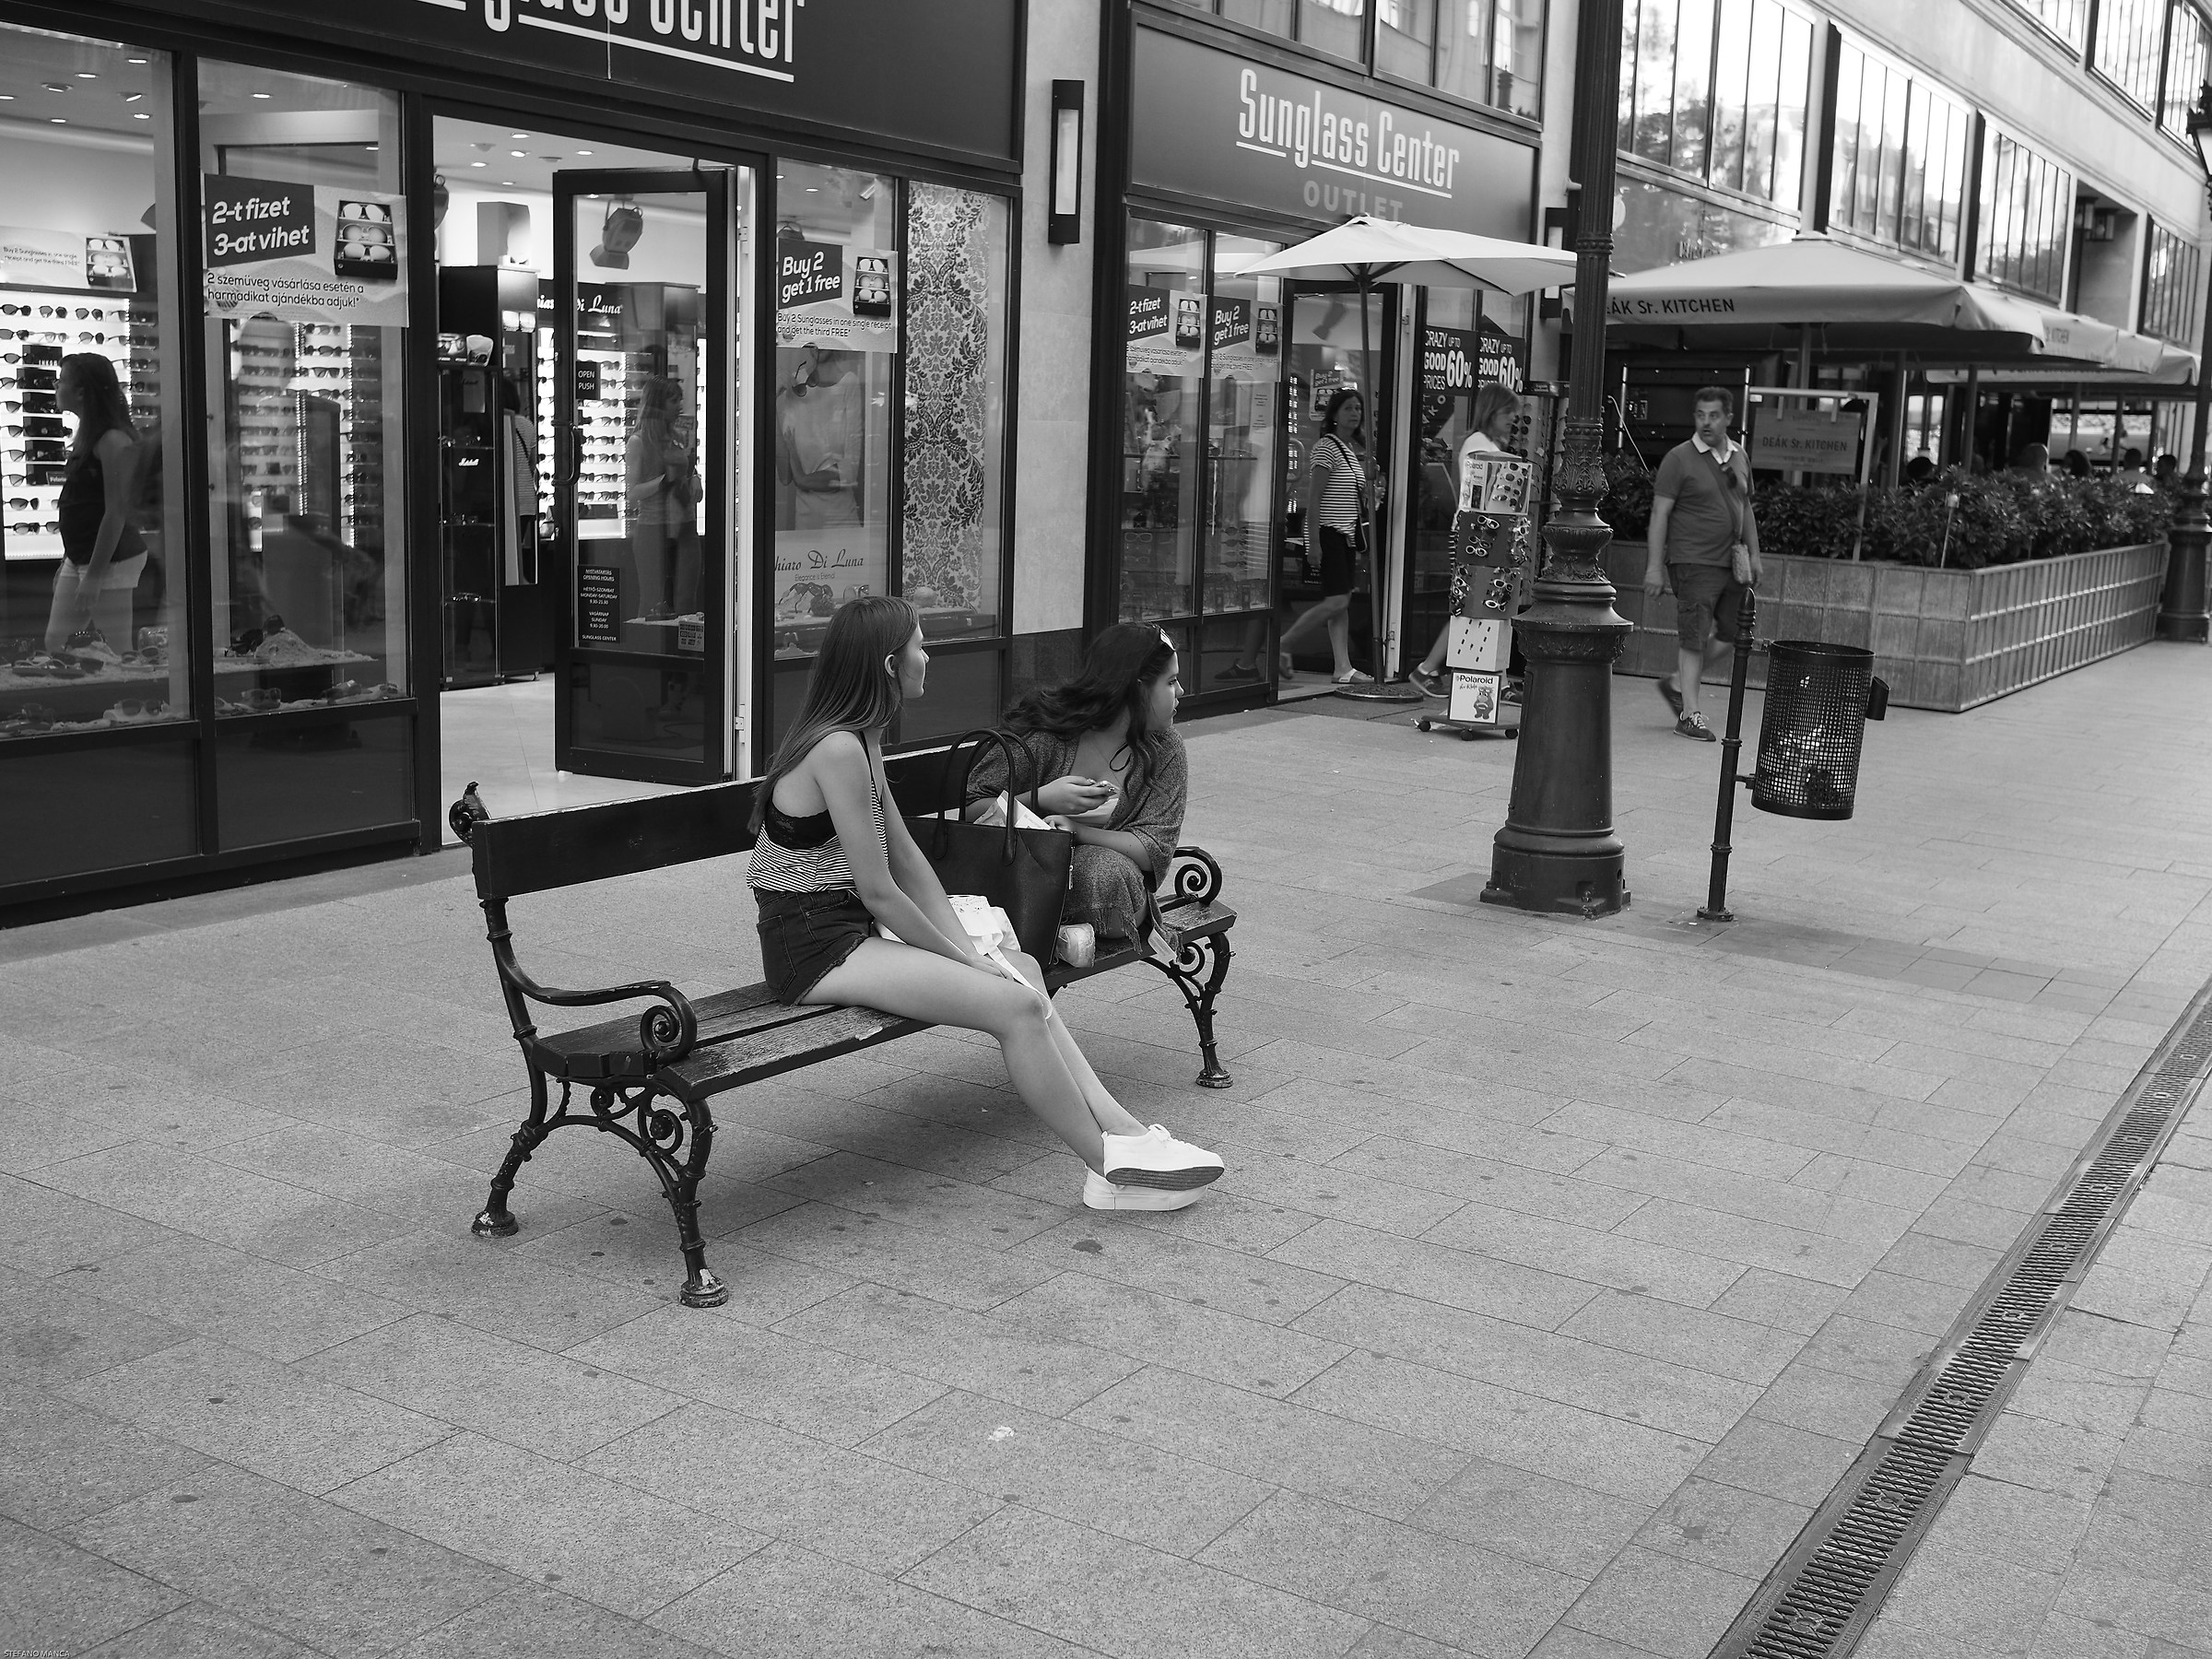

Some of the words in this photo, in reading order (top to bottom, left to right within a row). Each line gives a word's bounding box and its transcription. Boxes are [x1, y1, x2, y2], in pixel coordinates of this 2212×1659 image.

[1239, 68, 1369, 169] Sunglass
[1377, 111, 1460, 190] Center
[212, 201, 242, 225] 2-t
[245, 196, 290, 220] fizet
[1303, 180, 1403, 221] OUTLET
[213, 231, 256, 256] 3-at
[259, 225, 309, 250] vihet
[782, 256, 811, 279] Buy
[813, 251, 825, 271] 2
[207, 273, 215, 284] 2
[271, 277, 321, 291] vásárlása
[324, 282, 356, 293] esetén
[357, 284, 364, 293] a
[782, 277, 805, 303] get
[806, 276, 813, 293] 1
[815, 274, 841, 292] free
[207, 288, 270, 303] harmadikat
[271, 292, 324, 309] ajándékba
[1129, 300, 1143, 315] 2-t
[1142, 297, 1161, 312] fizet
[1607, 297, 1632, 314] ÁK
[1662, 299, 1735, 314] KITCHEN
[778, 312, 790, 324] Buy
[792, 314, 796, 323] 2
[797, 314, 832, 326] Sunglasses
[1129, 320, 1147, 334] 3-at
[1147, 314, 1168, 330] vihet
[1215, 310, 1232, 326] Buy
[1232, 305, 1240, 320] 2
[777, 325, 790, 334] and
[792, 327, 803, 336] get
[804, 326, 814, 335] the
[815, 327, 830, 336] third
[1214, 327, 1229, 346] get
[1229, 324, 1233, 338] 1
[1233, 323, 1249, 337] free
[578, 371, 595, 379] OPEN
[1447, 349, 1473, 389] 60%
[1499, 356, 1524, 393] 60%
[578, 382, 594, 390] PUSH
[1762, 435, 1787, 448] DEÁK
[1806, 439, 1848, 452] KITCHEN
[774, 556, 802, 571] hiaro
[808, 550, 828, 570] Di
[830, 548, 864, 569] Luna
[1460, 675, 1493, 685] Polaroid
